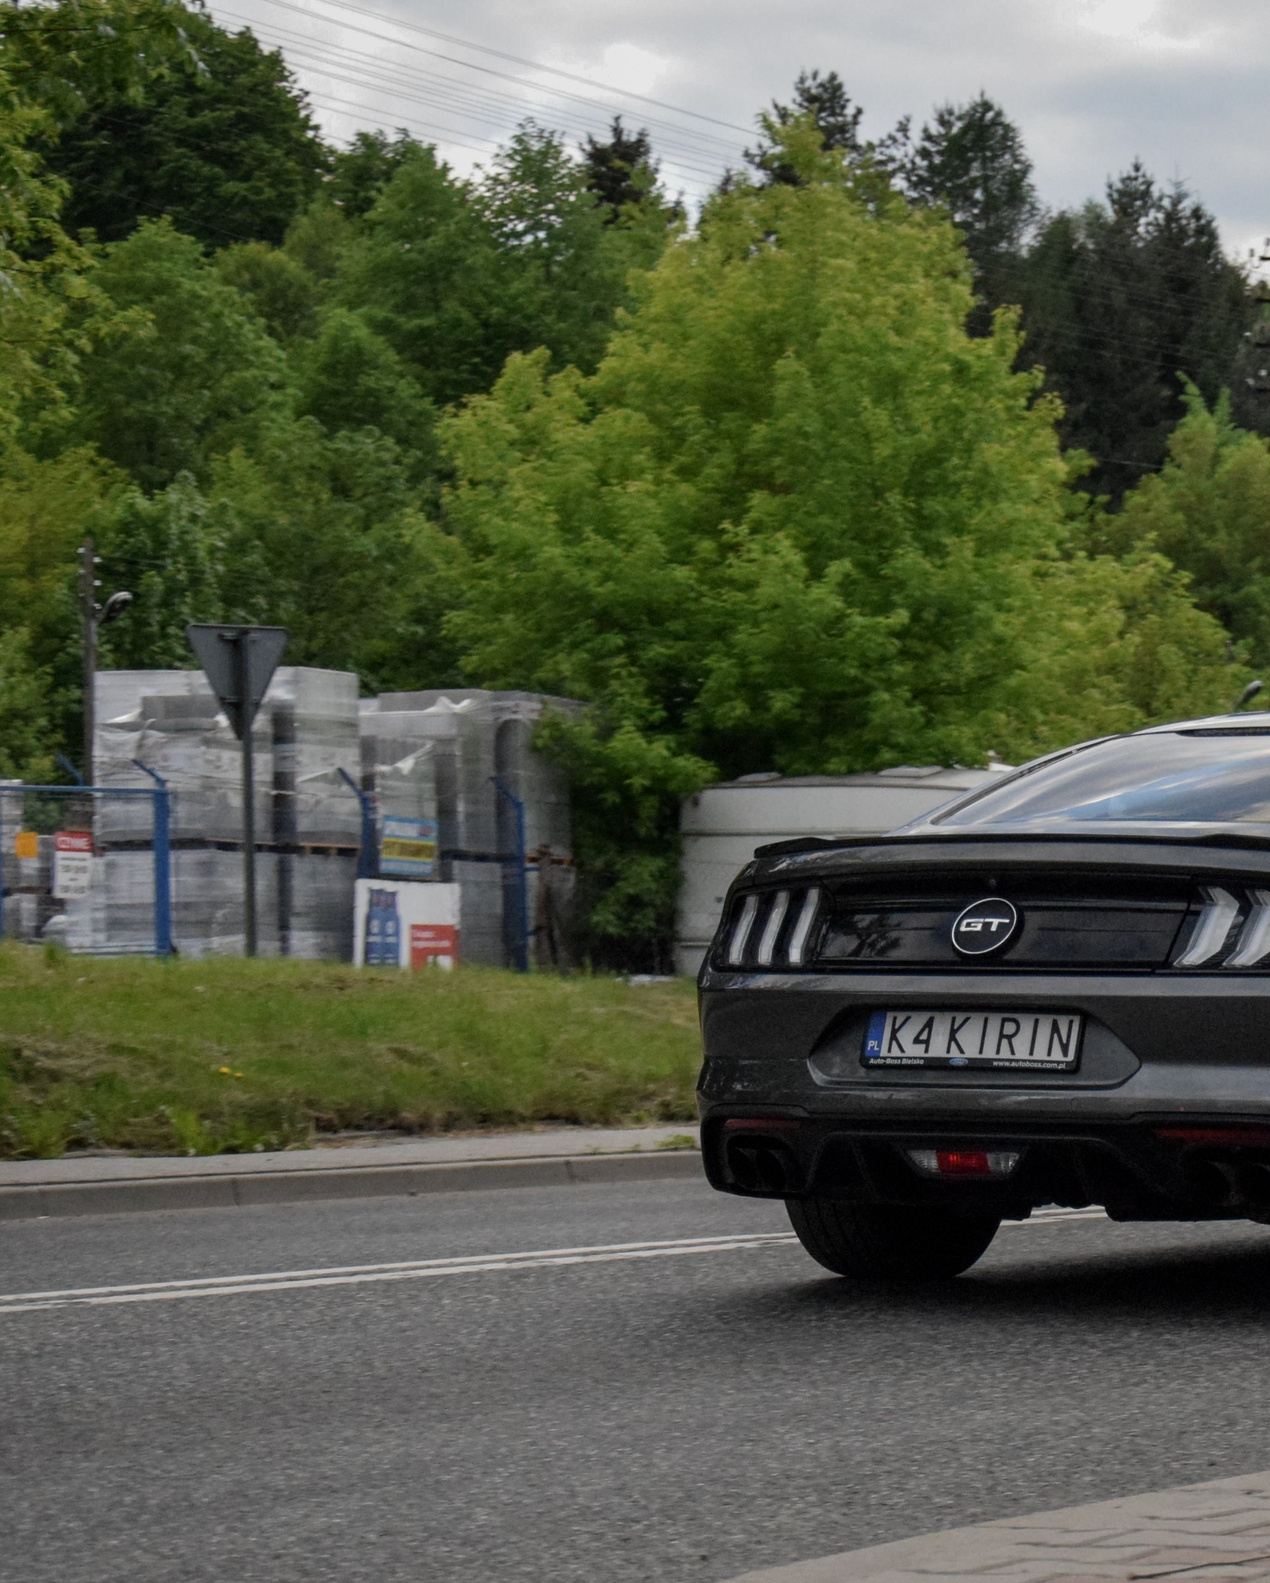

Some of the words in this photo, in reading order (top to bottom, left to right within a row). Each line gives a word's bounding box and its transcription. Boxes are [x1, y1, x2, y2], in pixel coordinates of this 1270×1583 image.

[960, 918, 1010, 931] GT
[867, 1040, 880, 1051] PL
[992, 1060, 1066, 1069] www.autoboss.com.pl
